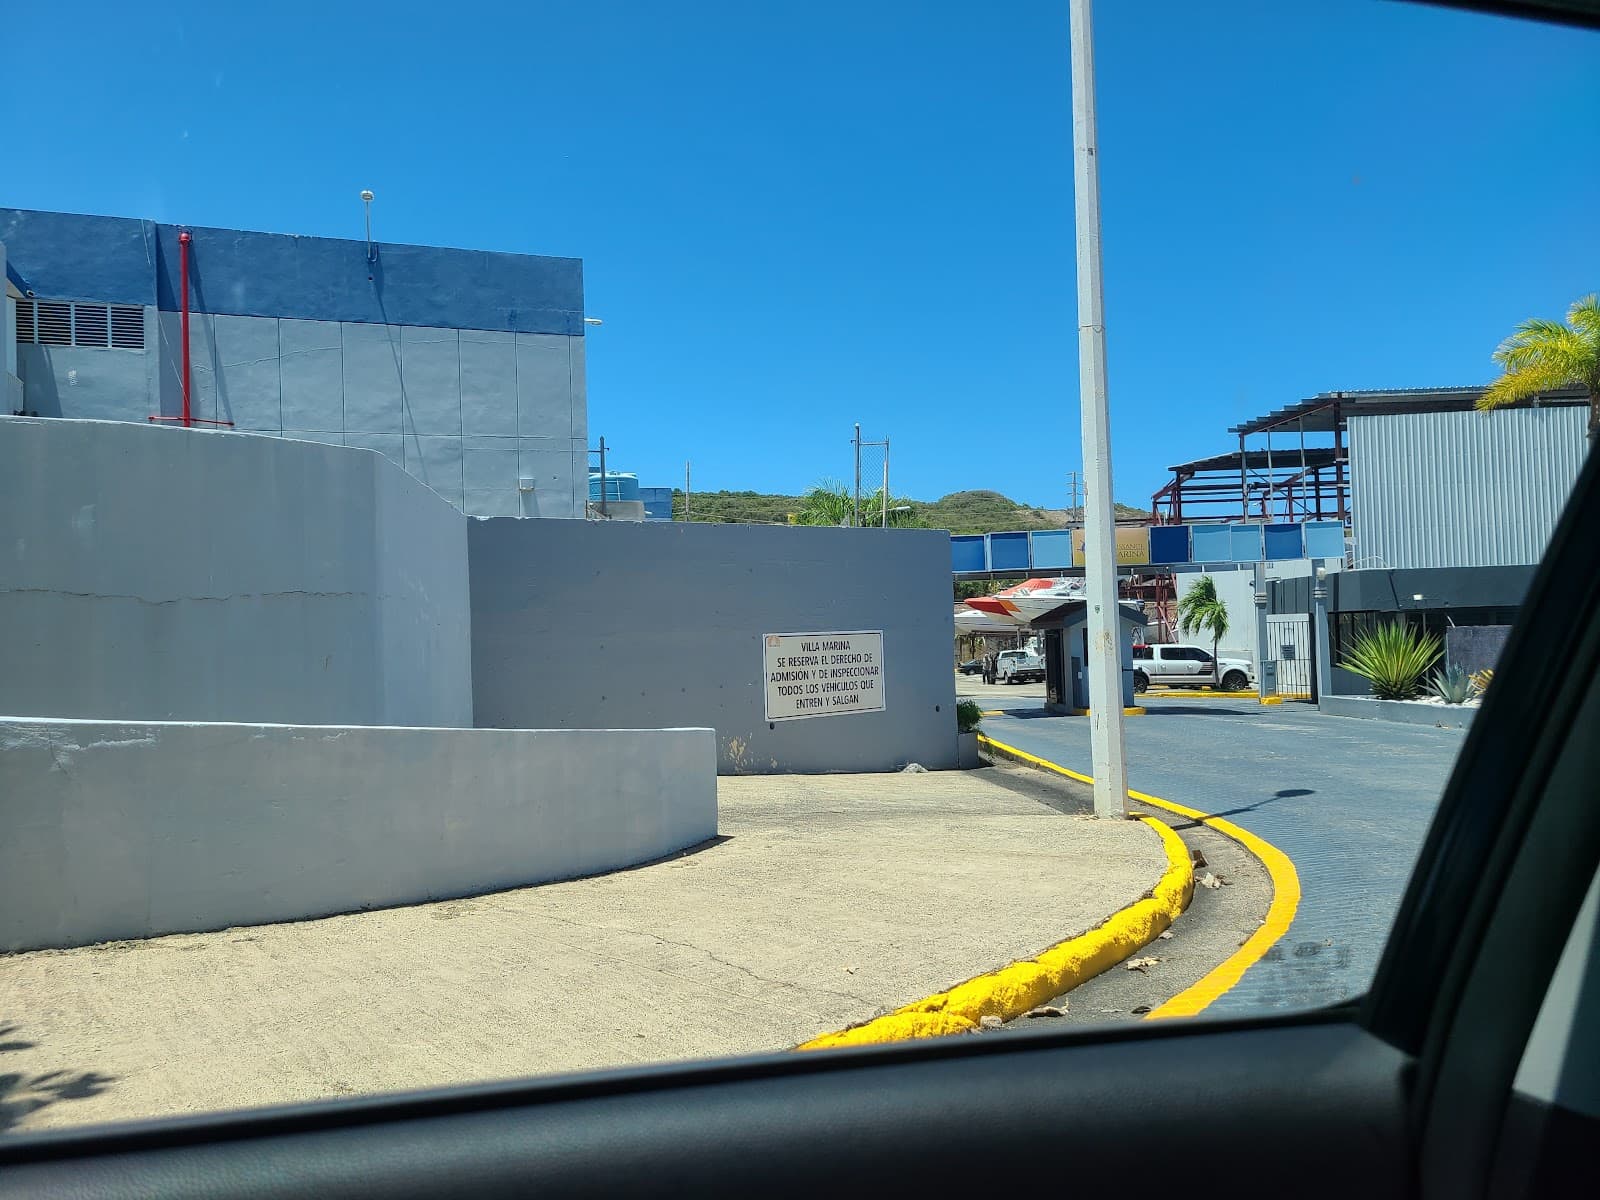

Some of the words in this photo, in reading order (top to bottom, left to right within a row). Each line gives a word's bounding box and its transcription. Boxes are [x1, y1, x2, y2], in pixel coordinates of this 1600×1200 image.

[1118, 550, 1145, 558] ARINA
[801, 641, 819, 652] VILLA
[823, 641, 850, 651] MARINA
[778, 658, 785, 667] SE
[789, 656, 818, 666] RESERVA
[822, 656, 828, 664] EL
[831, 654, 861, 664] DERECHO
[865, 653, 872, 662] DE
[812, 670, 816, 679] Y
[819, 669, 827, 678] DE
[831, 666, 879, 678] INSPECCIONAR
[778, 685, 803, 696] TODOS
[806, 684, 818, 693] LOS
[861, 680, 874, 690] QUE
[797, 698, 822, 708] ENTREN
[825, 698, 829, 706] Y
[832, 695, 858, 706] SALGAN
